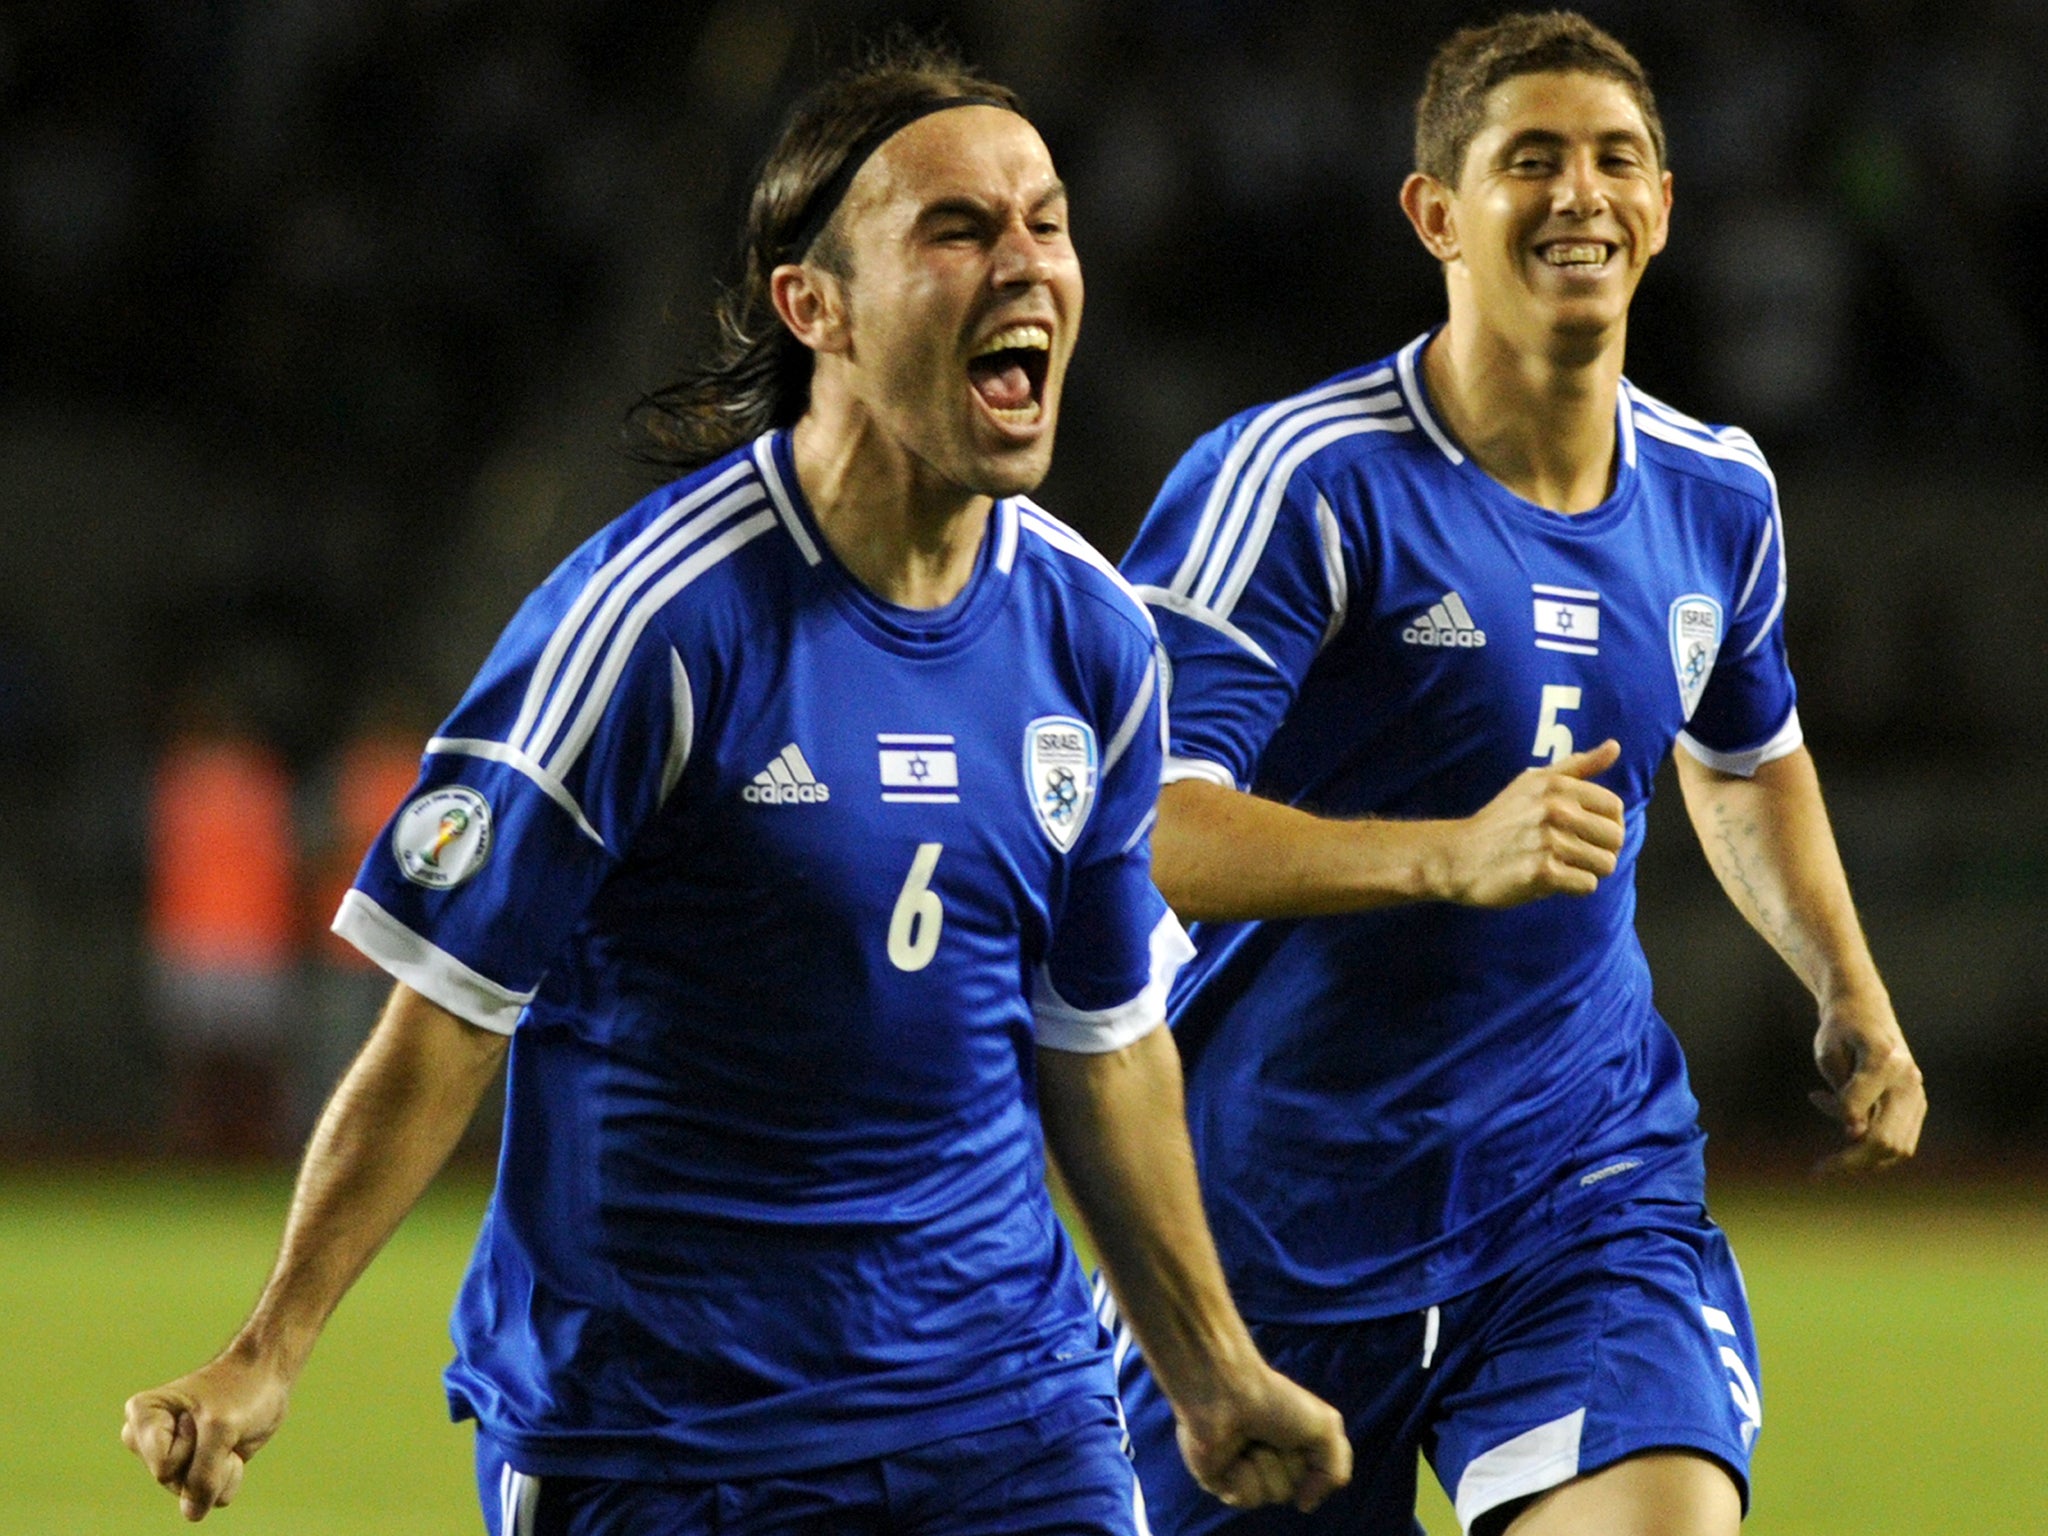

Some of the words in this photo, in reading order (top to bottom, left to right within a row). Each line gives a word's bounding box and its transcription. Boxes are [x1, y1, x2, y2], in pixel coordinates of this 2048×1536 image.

[1402, 627, 1487, 648] adidas
[1531, 684, 1582, 770] 5
[743, 782, 830, 804] adidas
[886, 842, 943, 972] 6
